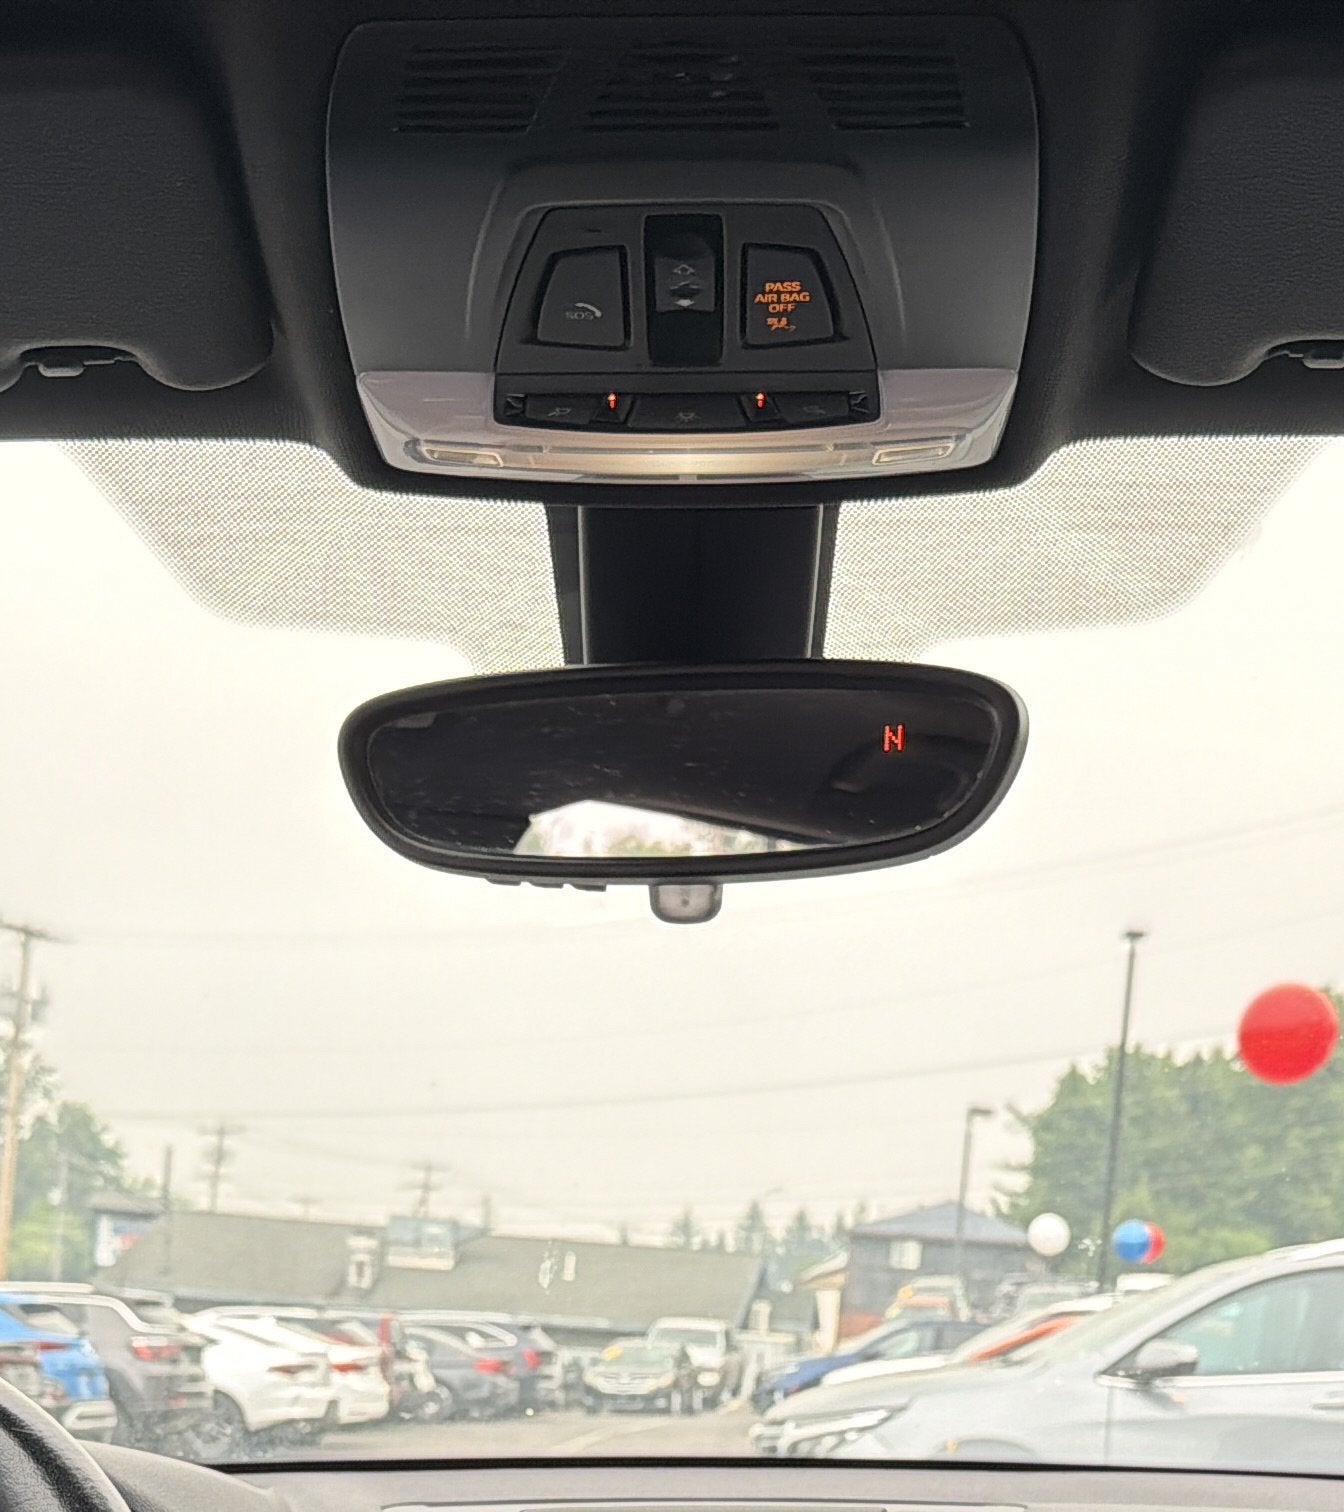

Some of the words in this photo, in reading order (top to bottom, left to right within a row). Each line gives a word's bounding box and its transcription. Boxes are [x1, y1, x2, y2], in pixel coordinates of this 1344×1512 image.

[765, 281, 801, 293] PASS
[754, 293, 778, 304] AIR
[780, 291, 811, 303] BAG
[768, 303, 795, 313] OFF
[883, 724, 905, 752] N
